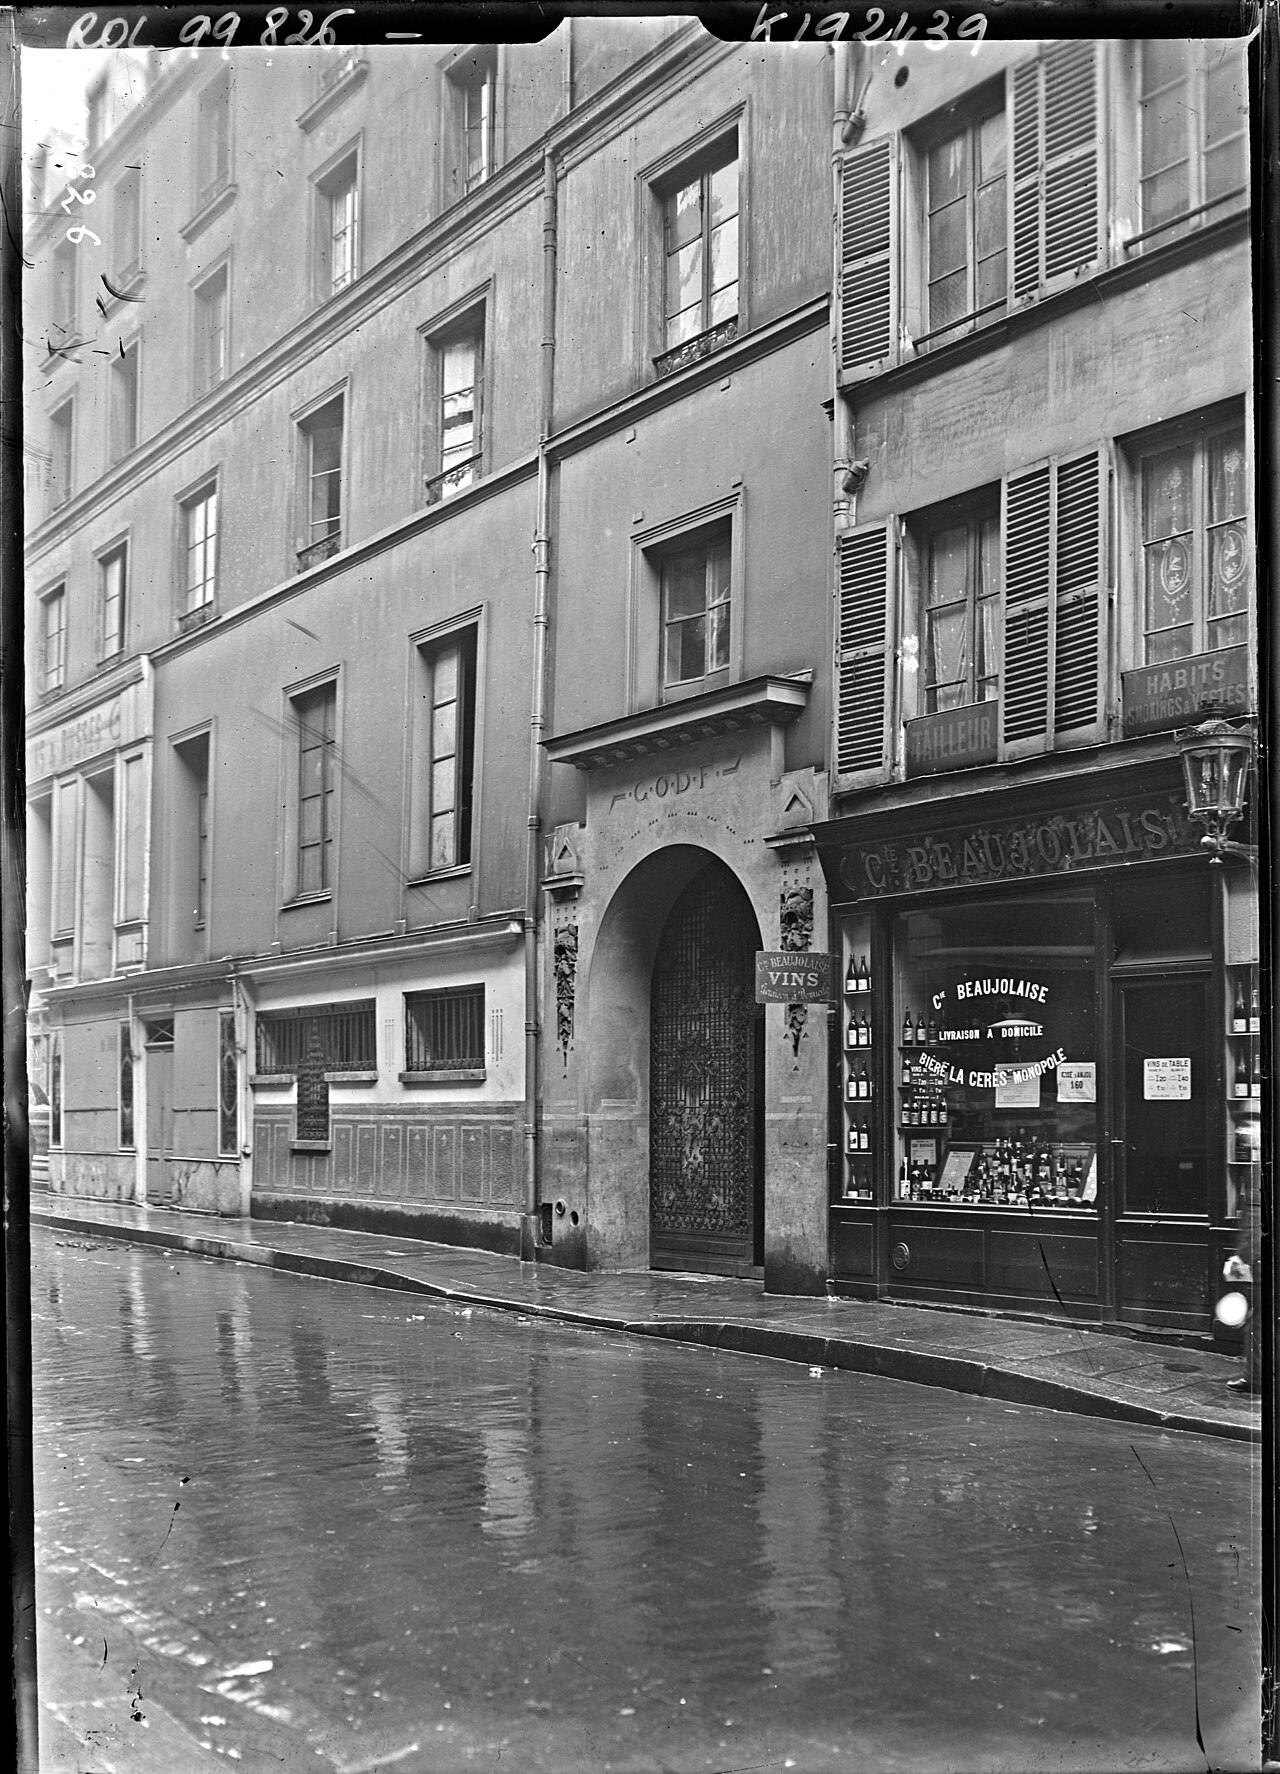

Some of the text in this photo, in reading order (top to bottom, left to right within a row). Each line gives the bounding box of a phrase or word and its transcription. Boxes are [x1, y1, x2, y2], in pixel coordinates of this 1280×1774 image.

[1147, 660, 1225, 695] HABITS
[1128, 696, 1183, 726] SMOKINGS
[1190, 683, 1246, 711] VESTES
[911, 716, 992, 763] TAILLEUR
[770, 955, 830, 973] BEAUJOLAISE
[767, 971, 819, 987] VINS
[957, 978, 1049, 1003] BEAUJOLAISE
[939, 1025, 1043, 1041] LIVRAISON A DOMICILE
[1013, 1048, 1067, 1084] MONOPOLE
[1146, 1060, 1160, 1068] VINS
[1169, 1060, 1189, 1068] TABLE
